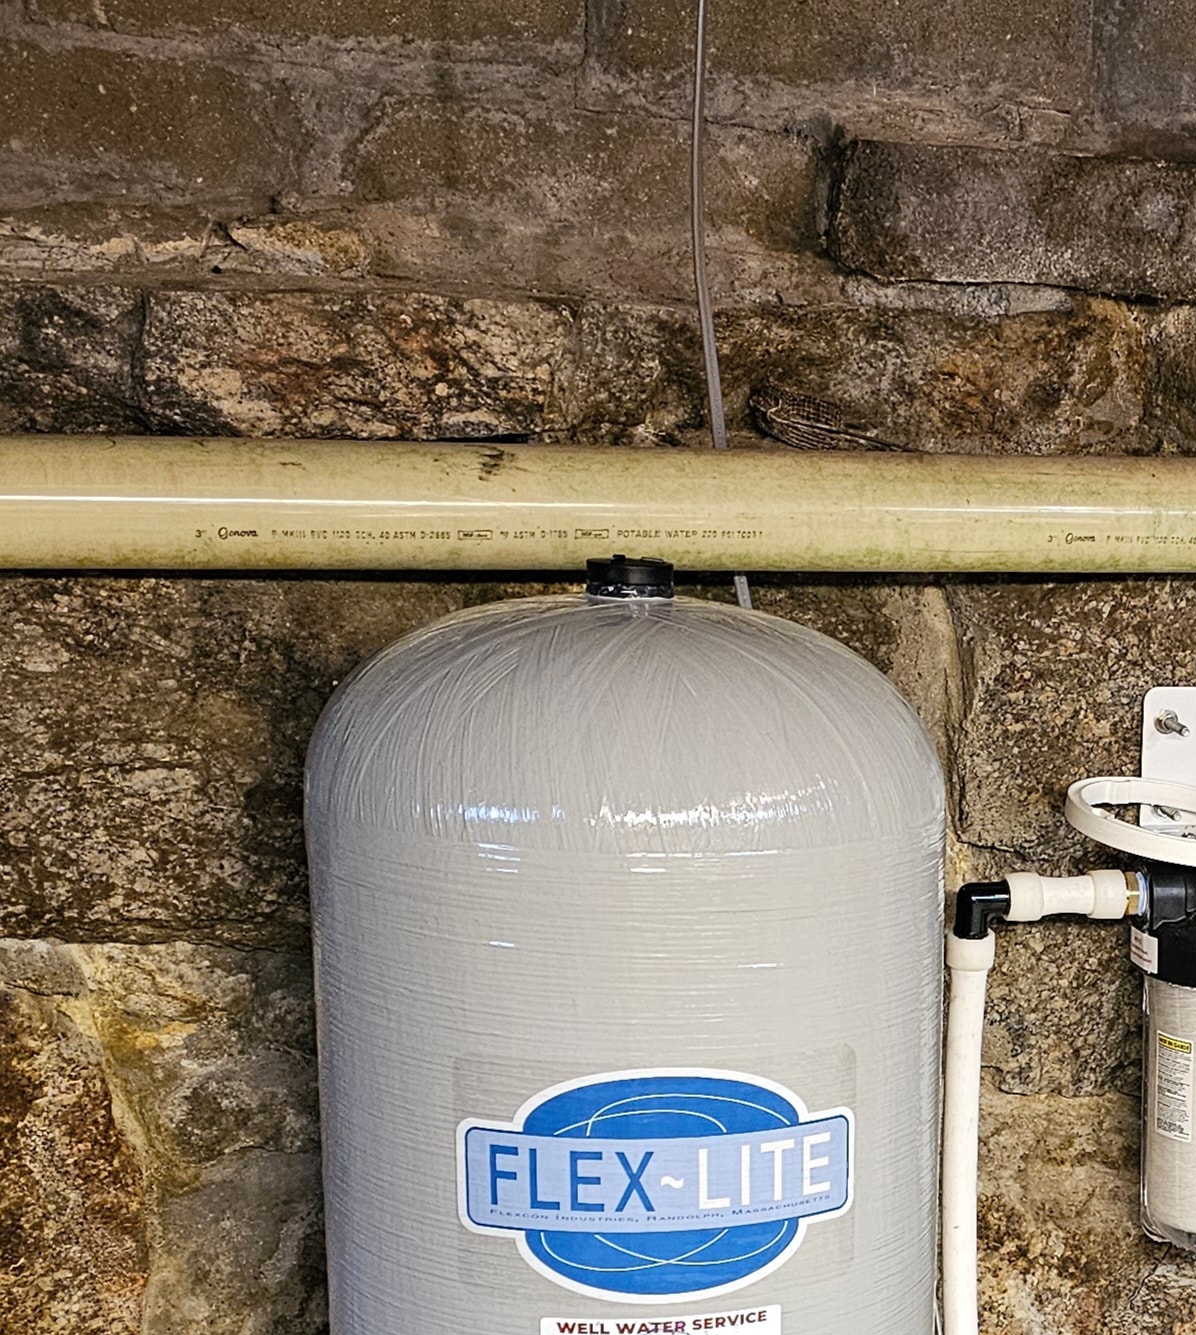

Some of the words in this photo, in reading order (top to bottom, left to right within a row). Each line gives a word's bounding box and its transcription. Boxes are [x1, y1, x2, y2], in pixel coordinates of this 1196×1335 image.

[217, 526, 259, 540] Genova
[393, 530, 417, 539] ASTM
[616, 529, 661, 538] POTABLE
[556, 1321, 610, 1335] WELL
[616, 1321, 686, 1335] WATER
[692, 1310, 768, 1331] SERVICE
